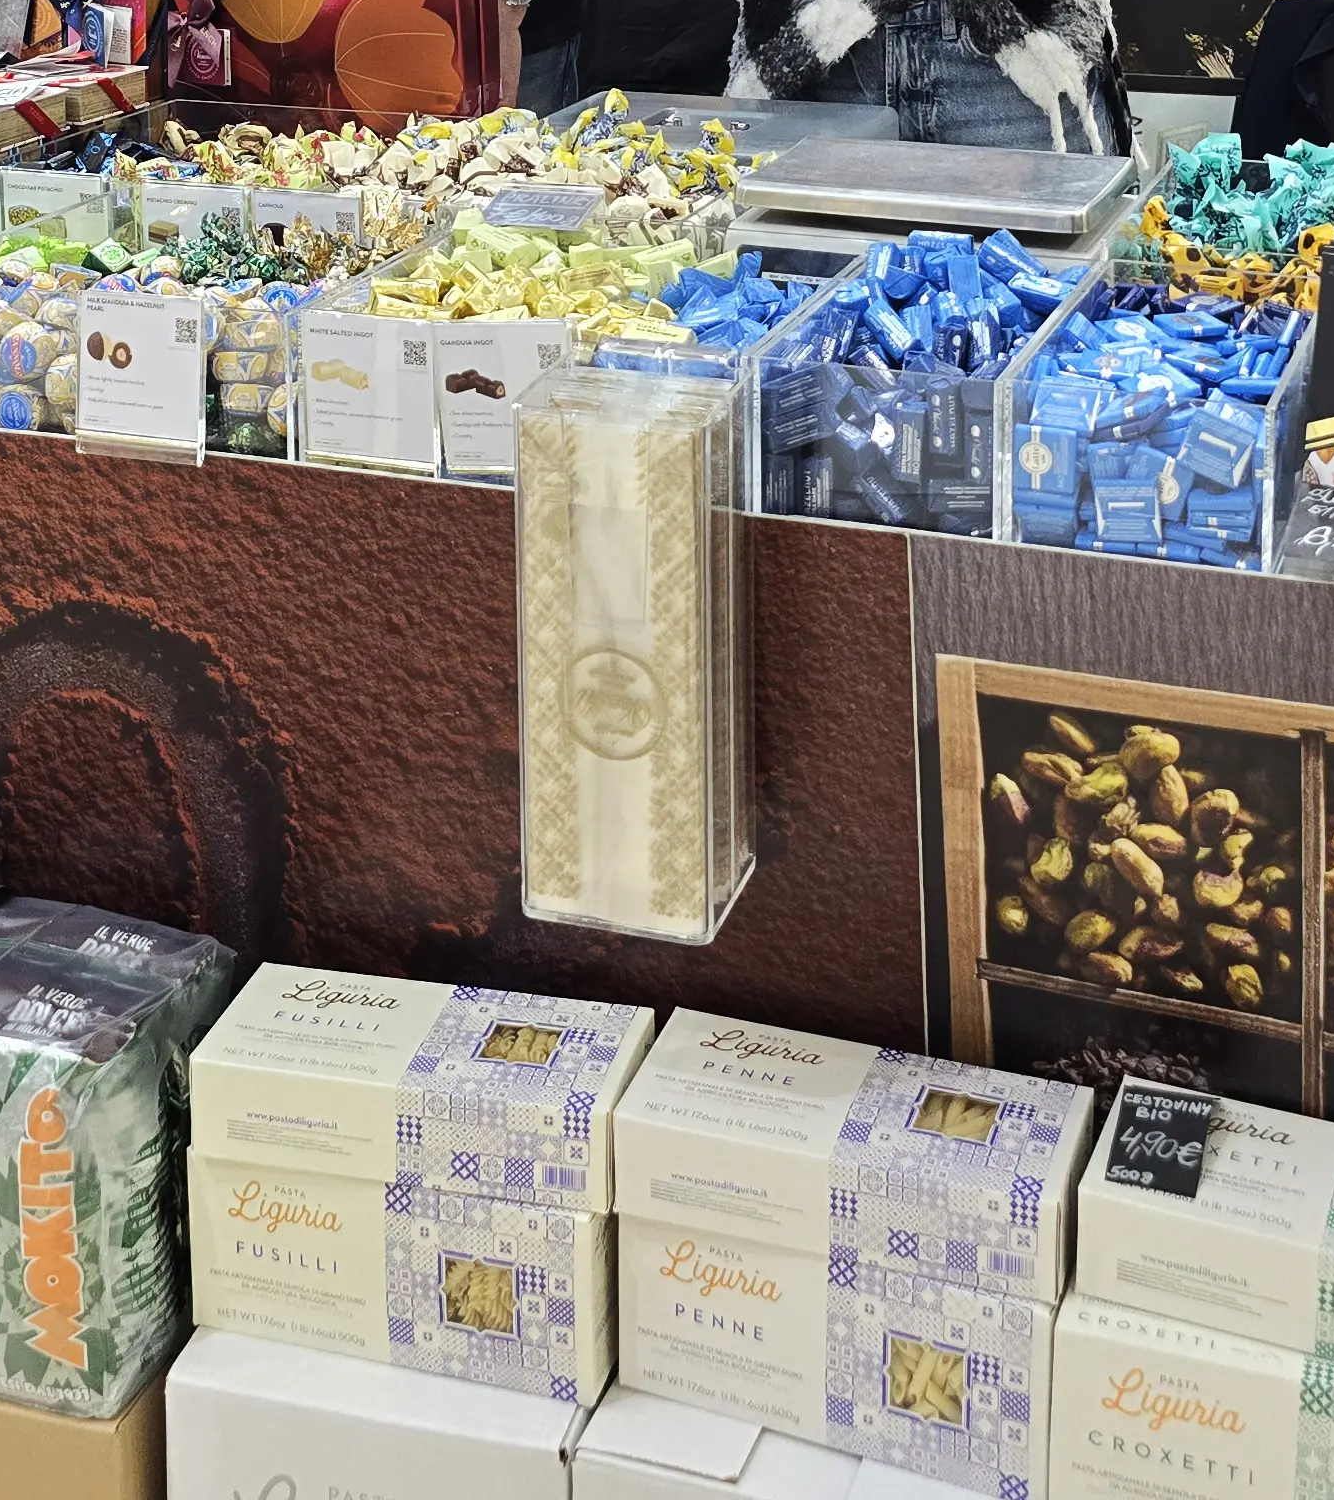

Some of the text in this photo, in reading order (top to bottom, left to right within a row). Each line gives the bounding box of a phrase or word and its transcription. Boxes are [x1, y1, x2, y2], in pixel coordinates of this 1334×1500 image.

[309, 327, 327, 336] WHITE
[329, 328, 351, 337] SALTED
[111, 928, 158, 951] VERDE
[281, 978, 401, 1010] Liguria
[273, 1011, 381, 1033] FUSILLI
[700, 1029, 825, 1066] Liguria
[703, 1060, 795, 1086] PENNE
[644, 1100, 809, 1142] NET WT 500g
[1123, 1090, 1212, 1117] CESTOVINY
[1136, 1105, 1172, 1123] BIO
[1118, 1128, 1203, 1168] 4,90€
[228, 1179, 343, 1233] Liguria
[274, 1184, 307, 1199] PASTA
[18, 1086, 89, 1370] MOKITO
[235, 1239, 339, 1274] FUSILLI
[659, 1239, 782, 1303] Liguria
[709, 1245, 743, 1263] PASTA
[674, 1303, 765, 1342] PENNE
[1077, 1311, 1216, 1350] CROXETTI
[1101, 1367, 1247, 1433] Liguria
[1160, 1373, 1200, 1393] PASTA
[1088, 1429, 1255, 1487] CROXETTI
